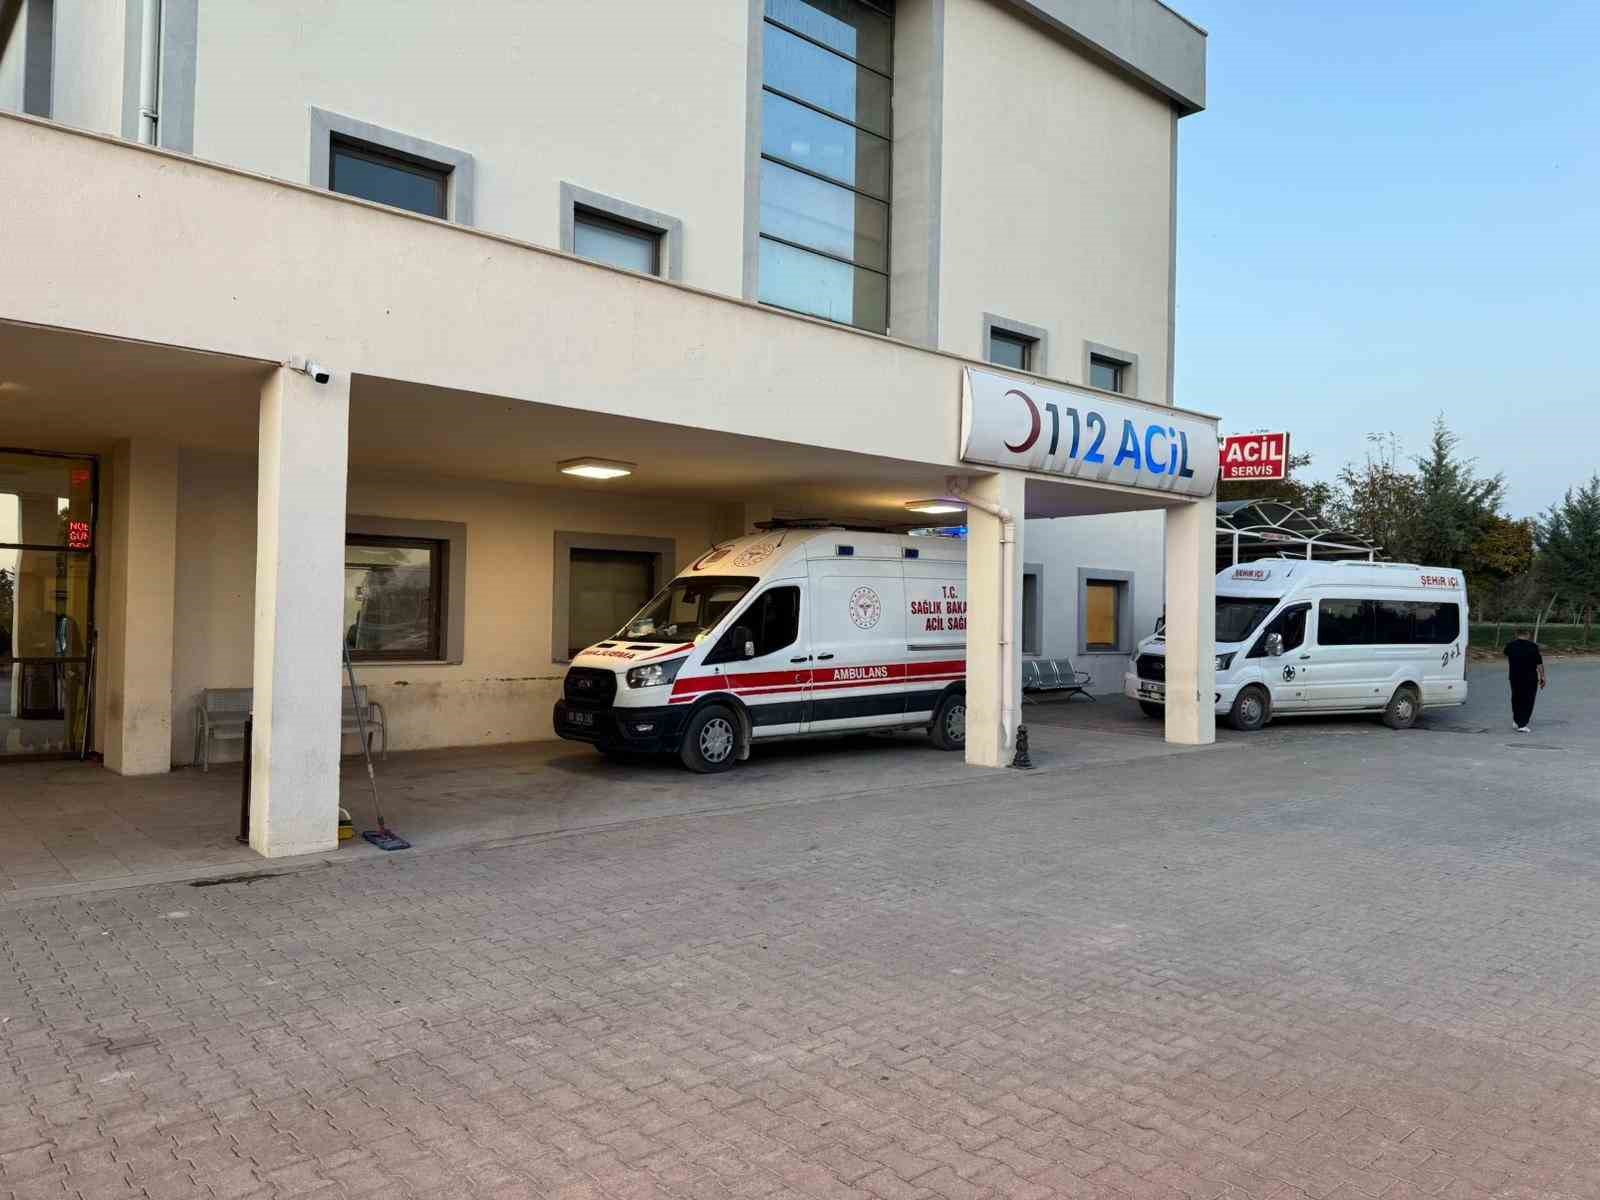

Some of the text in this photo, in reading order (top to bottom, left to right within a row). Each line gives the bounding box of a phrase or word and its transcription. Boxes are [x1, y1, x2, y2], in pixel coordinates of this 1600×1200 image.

[1045, 402, 1106, 464] 112
[1231, 463, 1273, 477] SERVİS
[941, 585, 958, 599] T.C.
[911, 599, 942, 615] SAĞLIK
[833, 666, 888, 681] AMBULANS
